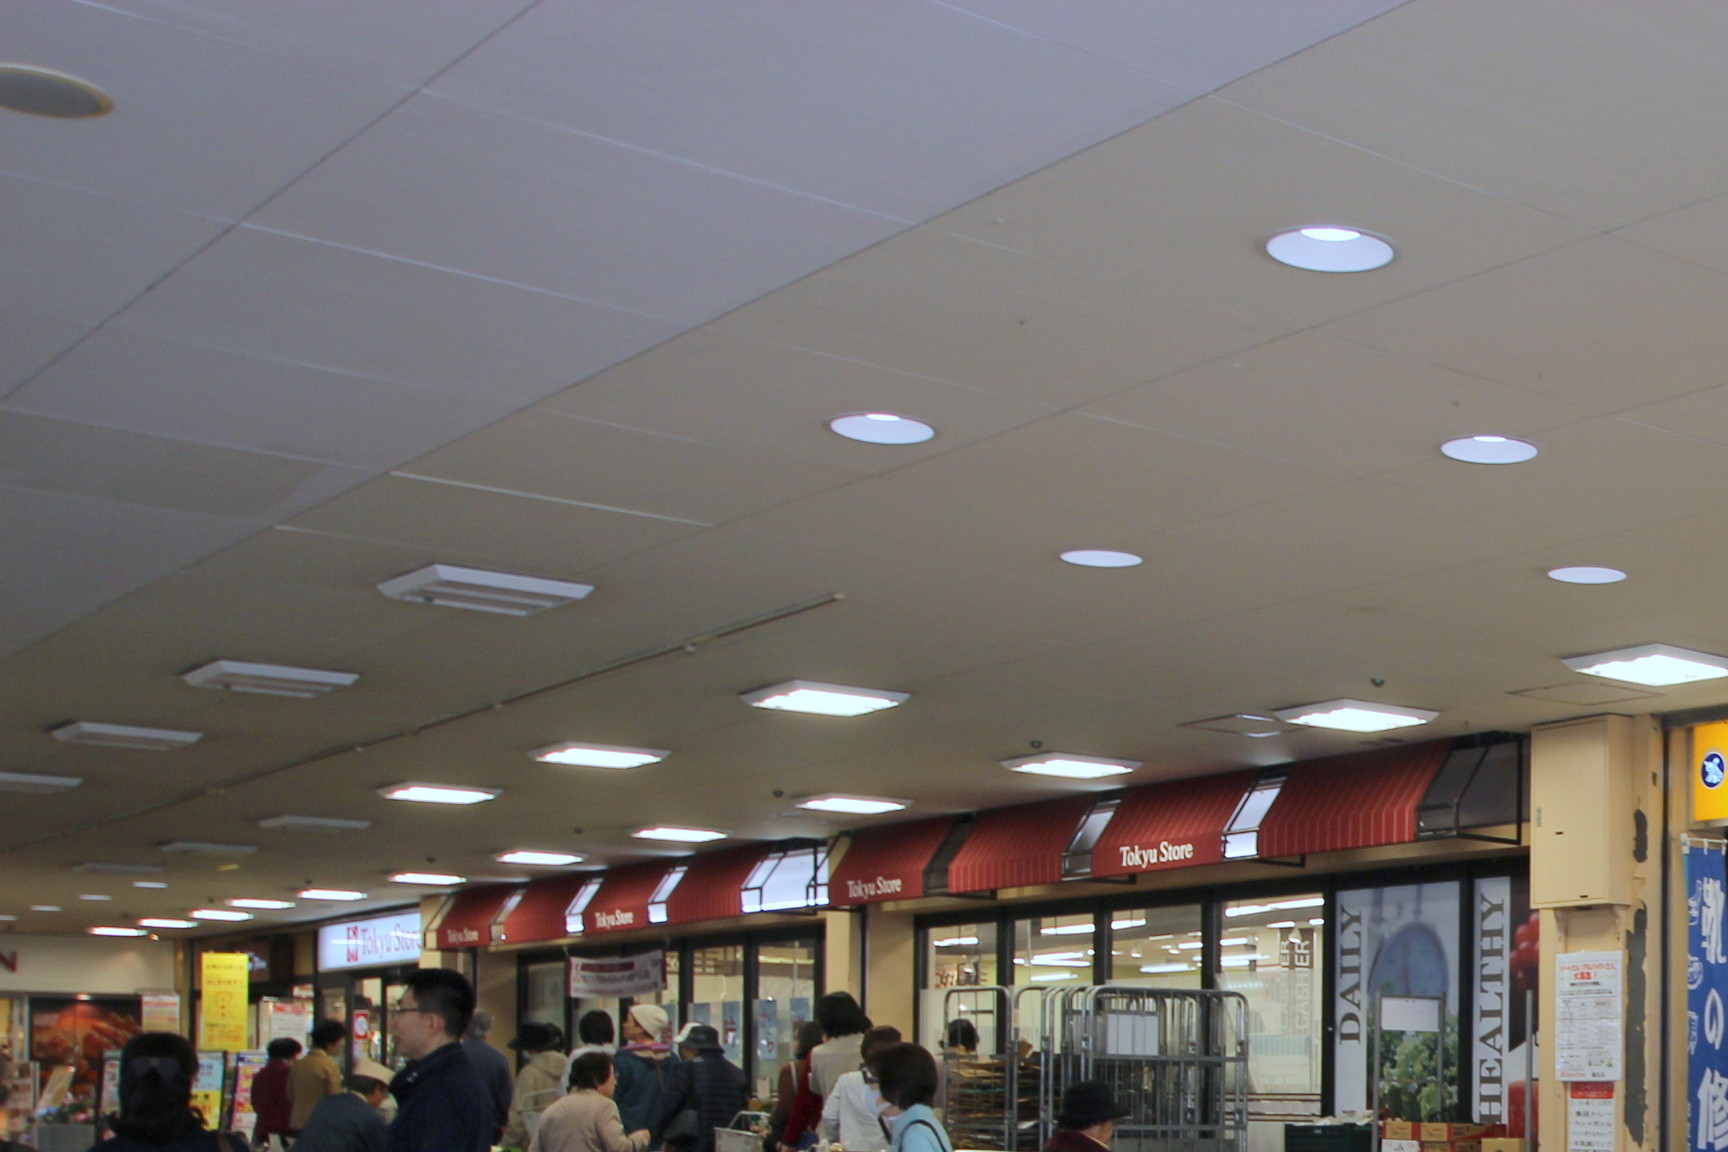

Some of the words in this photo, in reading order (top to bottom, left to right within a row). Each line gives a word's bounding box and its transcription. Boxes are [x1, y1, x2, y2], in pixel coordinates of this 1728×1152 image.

[1119, 845, 1158, 868] Tokyu
[1159, 840, 1194, 862] Store
[847, 879, 877, 899] Tokyu
[876, 876, 902, 894] Store
[594, 911, 615, 930] Tokyu
[614, 908, 634, 925] Store
[361, 926, 391, 959] Tokyu
[462, 926, 480, 943] Store
[1339, 903, 1362, 1045] DAILY
[1478, 891, 1506, 1124] HEALTHY
